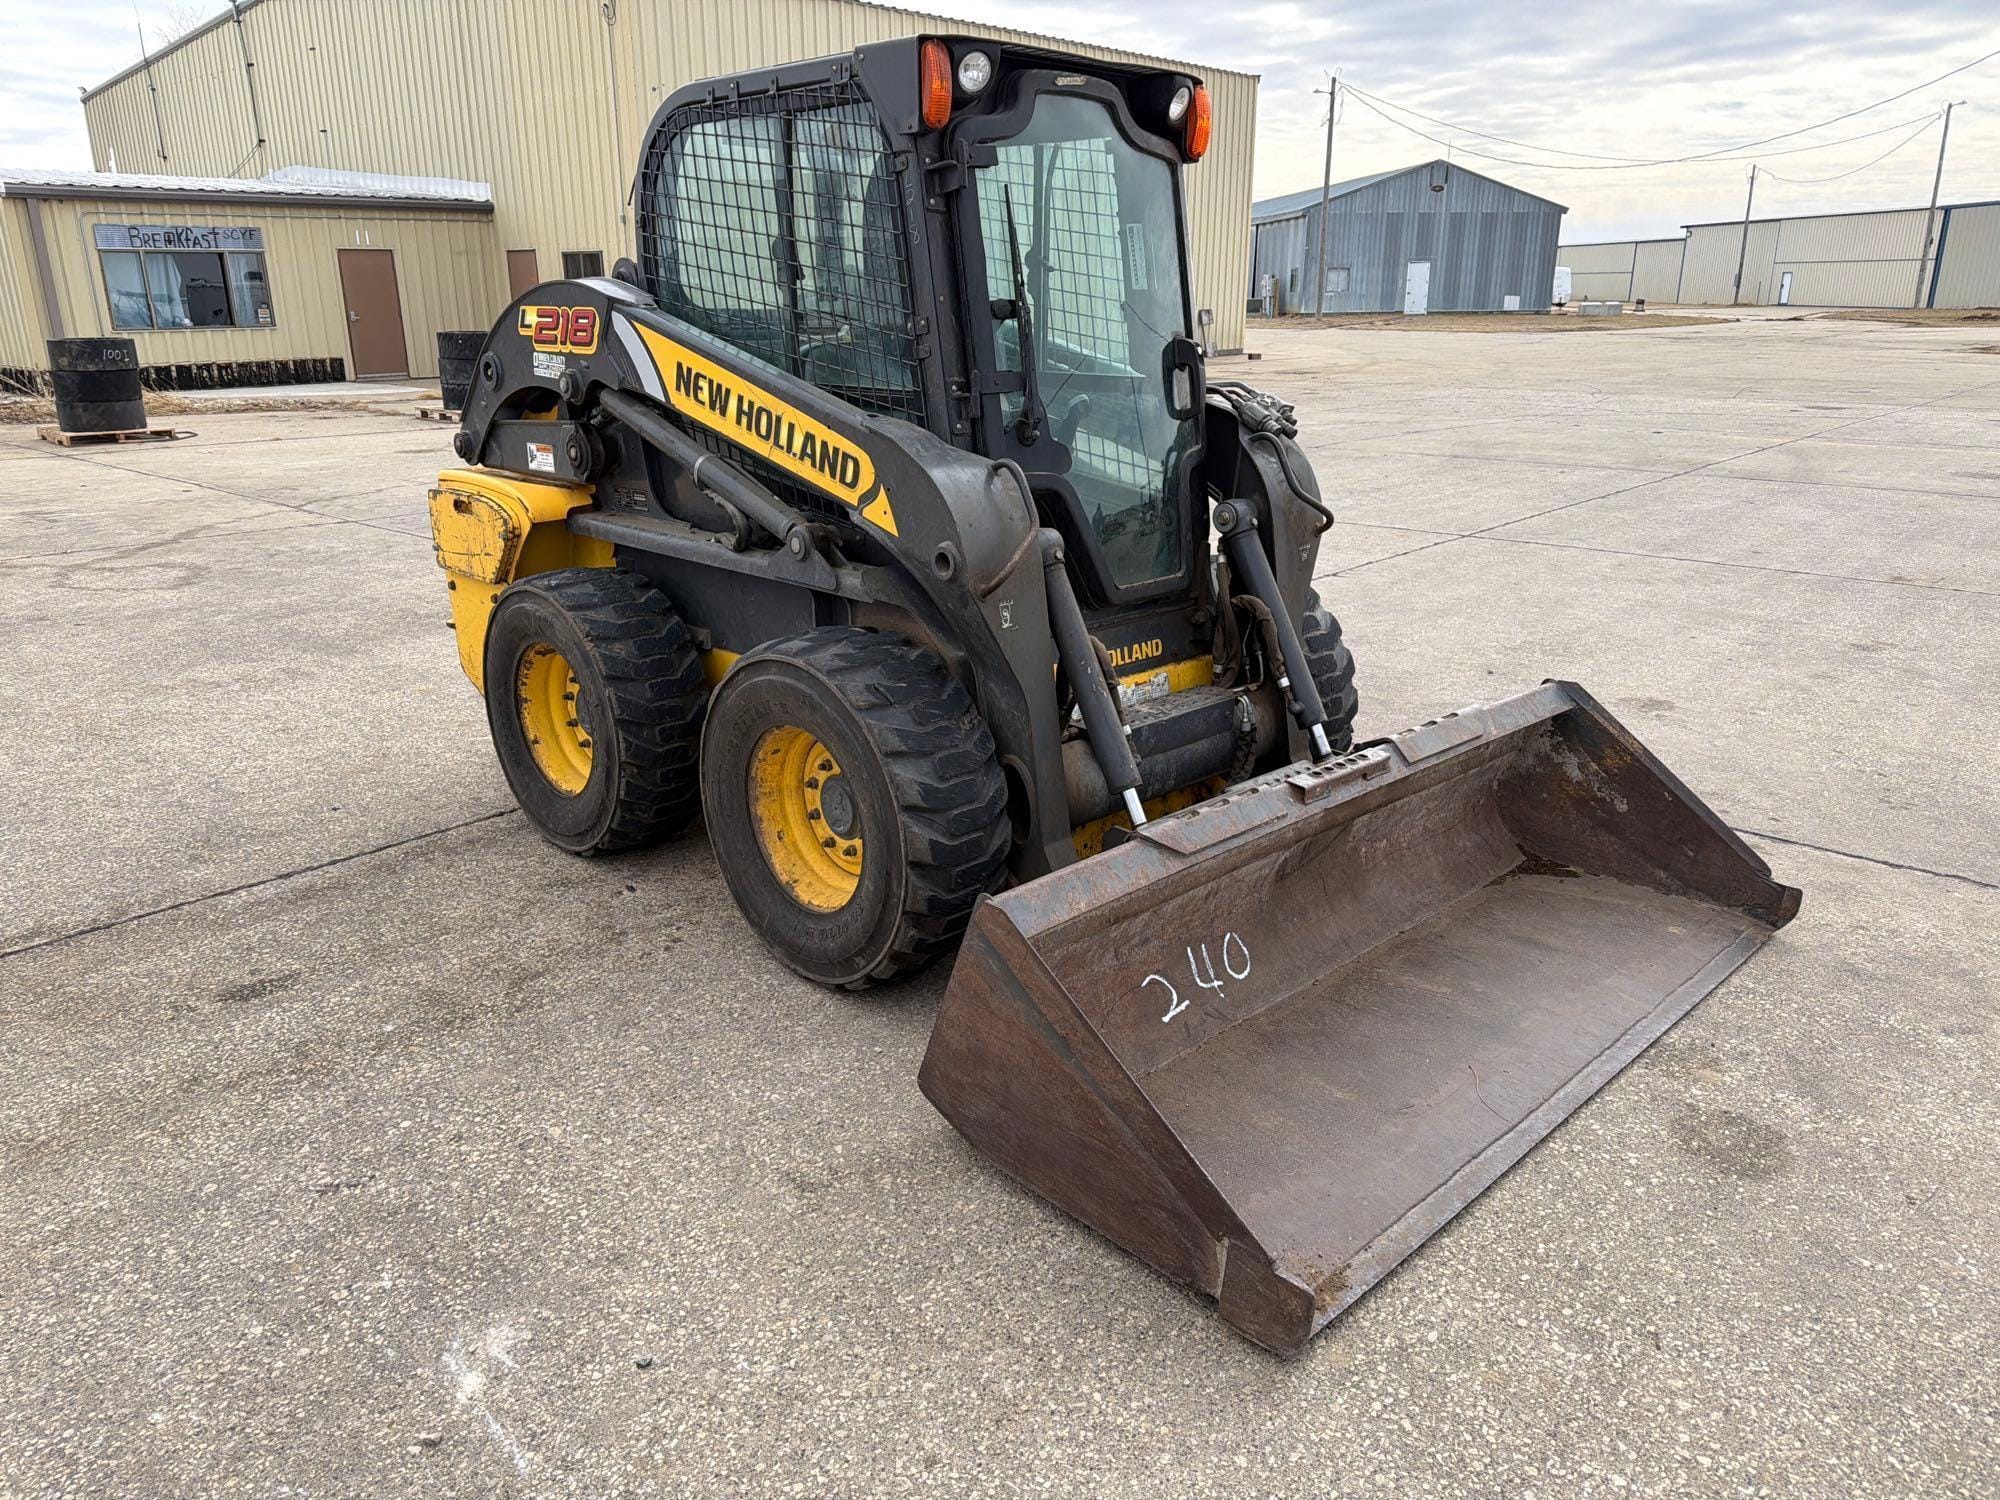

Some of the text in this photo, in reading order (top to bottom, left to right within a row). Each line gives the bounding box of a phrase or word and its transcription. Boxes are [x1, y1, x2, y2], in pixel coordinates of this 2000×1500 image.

[519, 306, 599, 353] L218
[675, 361, 860, 490] NEW HOLLAND
[1107, 638, 1163, 667] OLLAND
[1141, 932, 1251, 1023] 240
